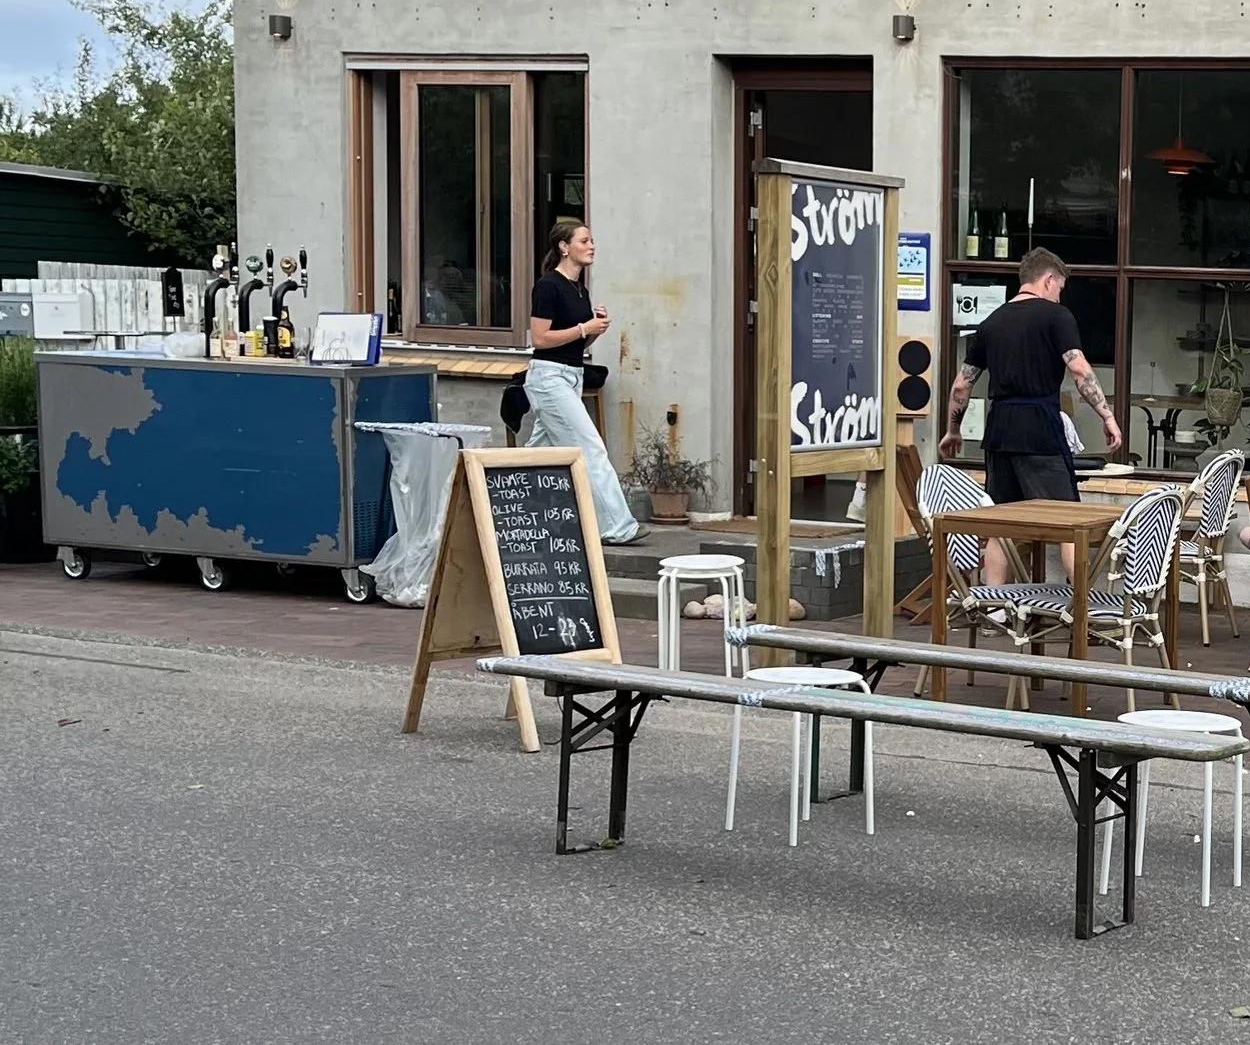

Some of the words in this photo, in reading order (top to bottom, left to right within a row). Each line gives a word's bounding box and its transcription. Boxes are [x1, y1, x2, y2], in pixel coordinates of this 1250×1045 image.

[790, 381, 880, 446] Ström
[486, 473, 529, 489] SVAMPE
[491, 503, 526, 515] OLIVE
[502, 561, 548, 578] BURRATA
[506, 581, 554, 596] SERRANO
[511, 601, 554, 620] ÅBENT
